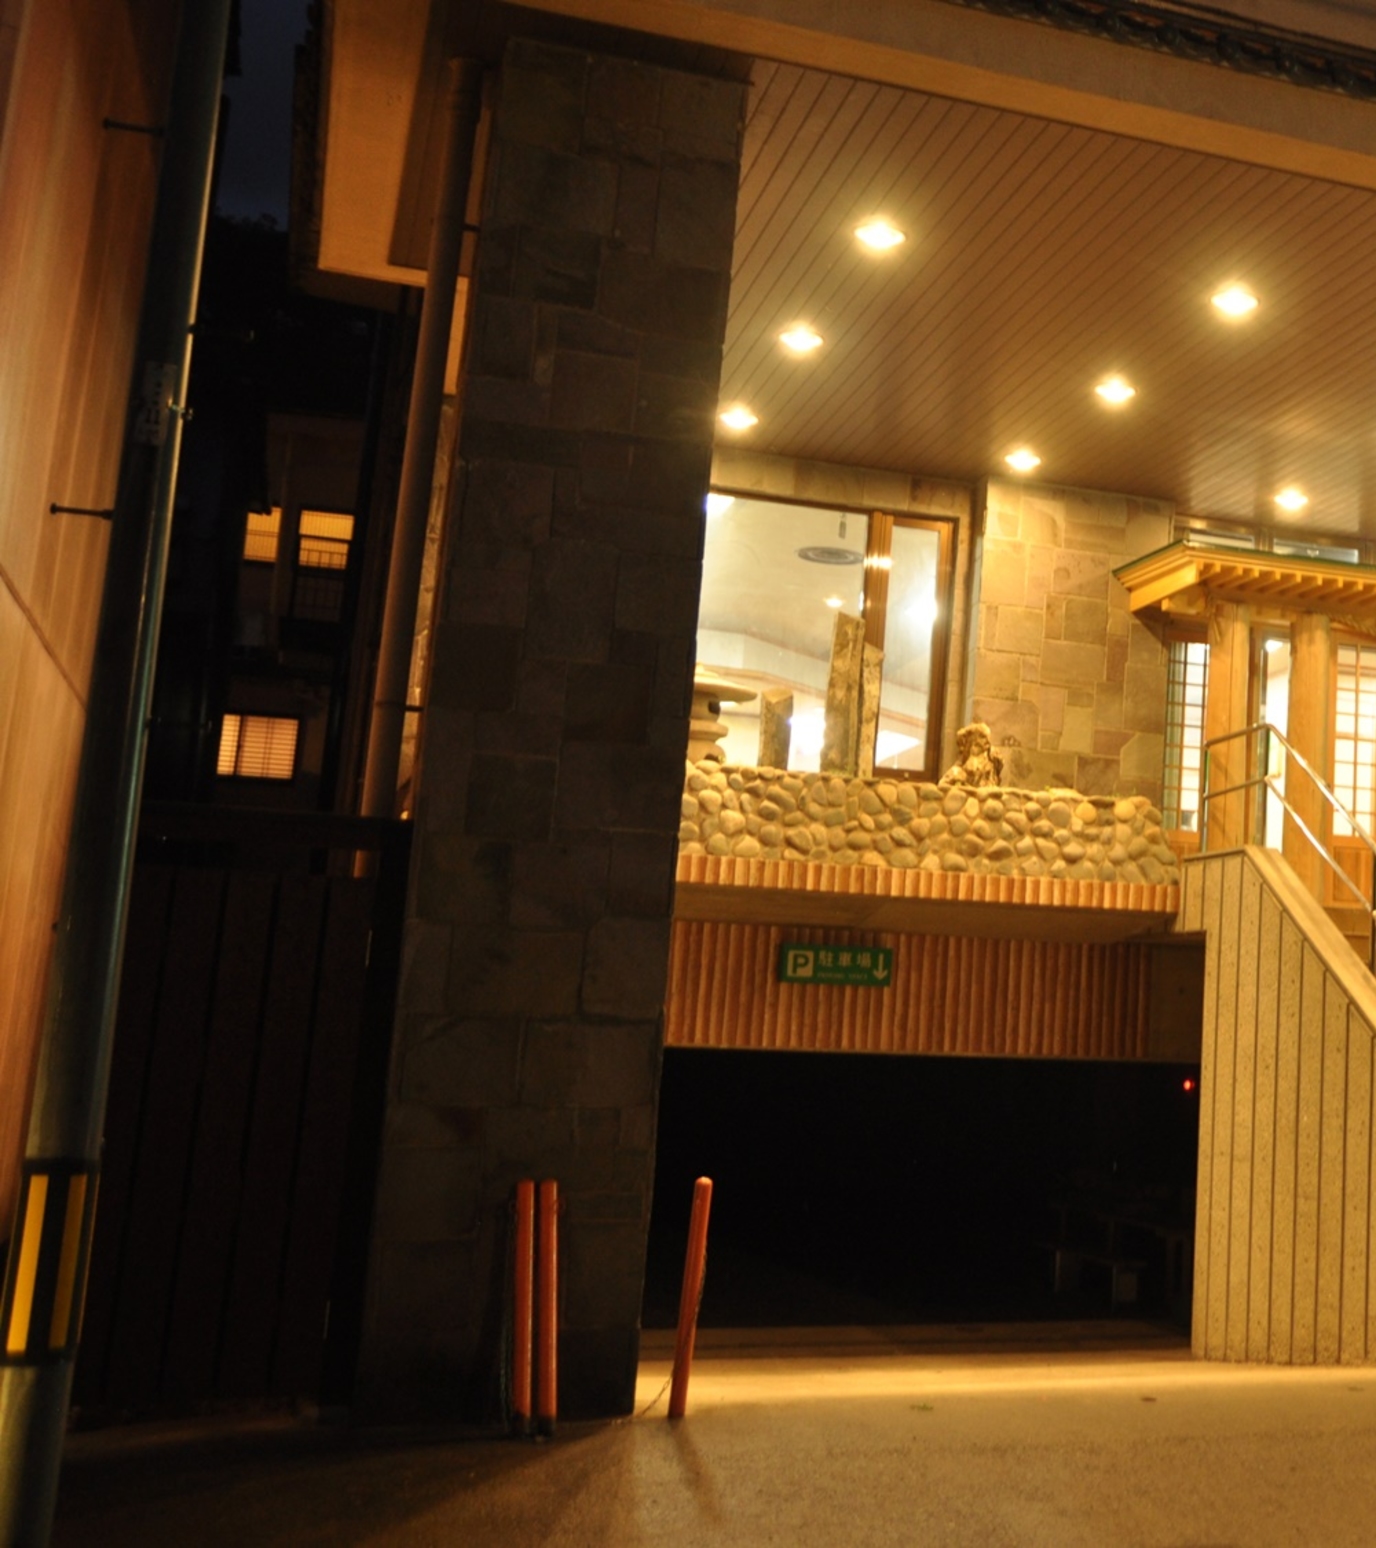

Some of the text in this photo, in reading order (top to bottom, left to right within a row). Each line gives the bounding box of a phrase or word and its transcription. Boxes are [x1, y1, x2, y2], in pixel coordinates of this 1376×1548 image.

[791, 953, 810, 974] P
[818, 950, 872, 968] 駐車場
